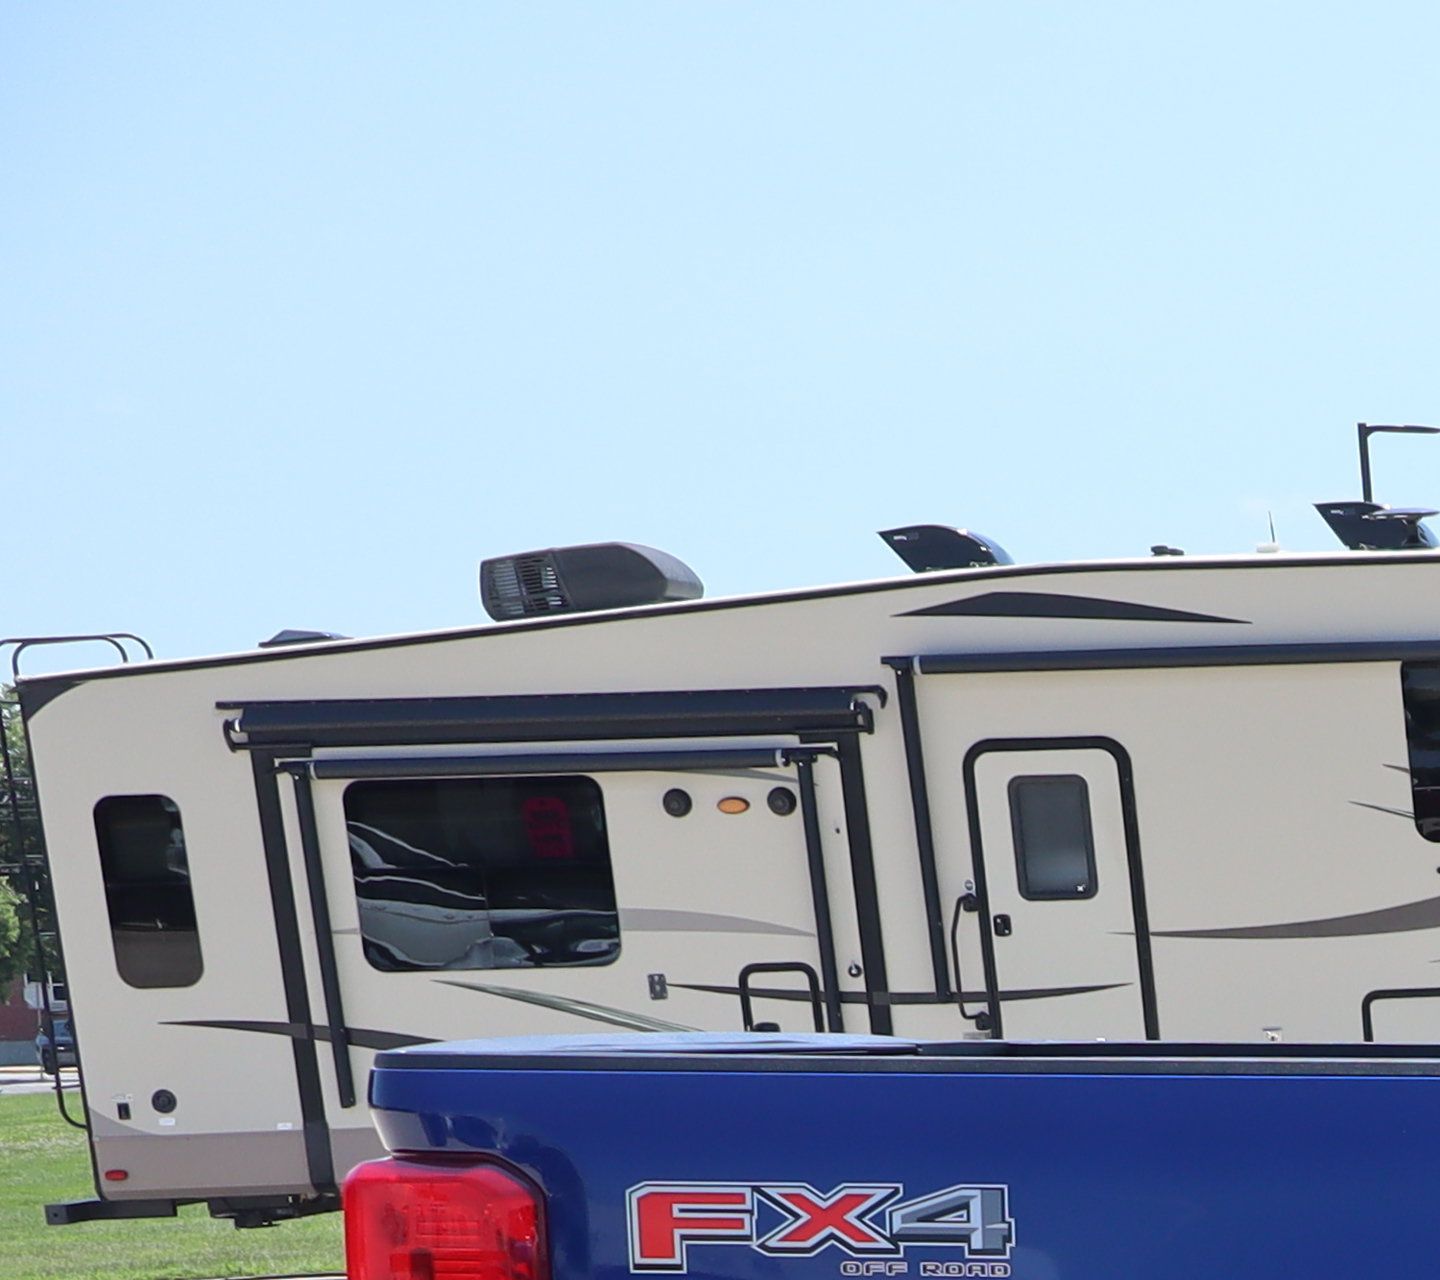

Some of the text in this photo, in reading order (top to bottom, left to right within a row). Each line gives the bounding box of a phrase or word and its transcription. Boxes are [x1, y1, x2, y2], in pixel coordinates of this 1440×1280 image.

[625, 1180, 1016, 1274] FX4
[840, 1260, 1011, 1278] OFF ROAD
